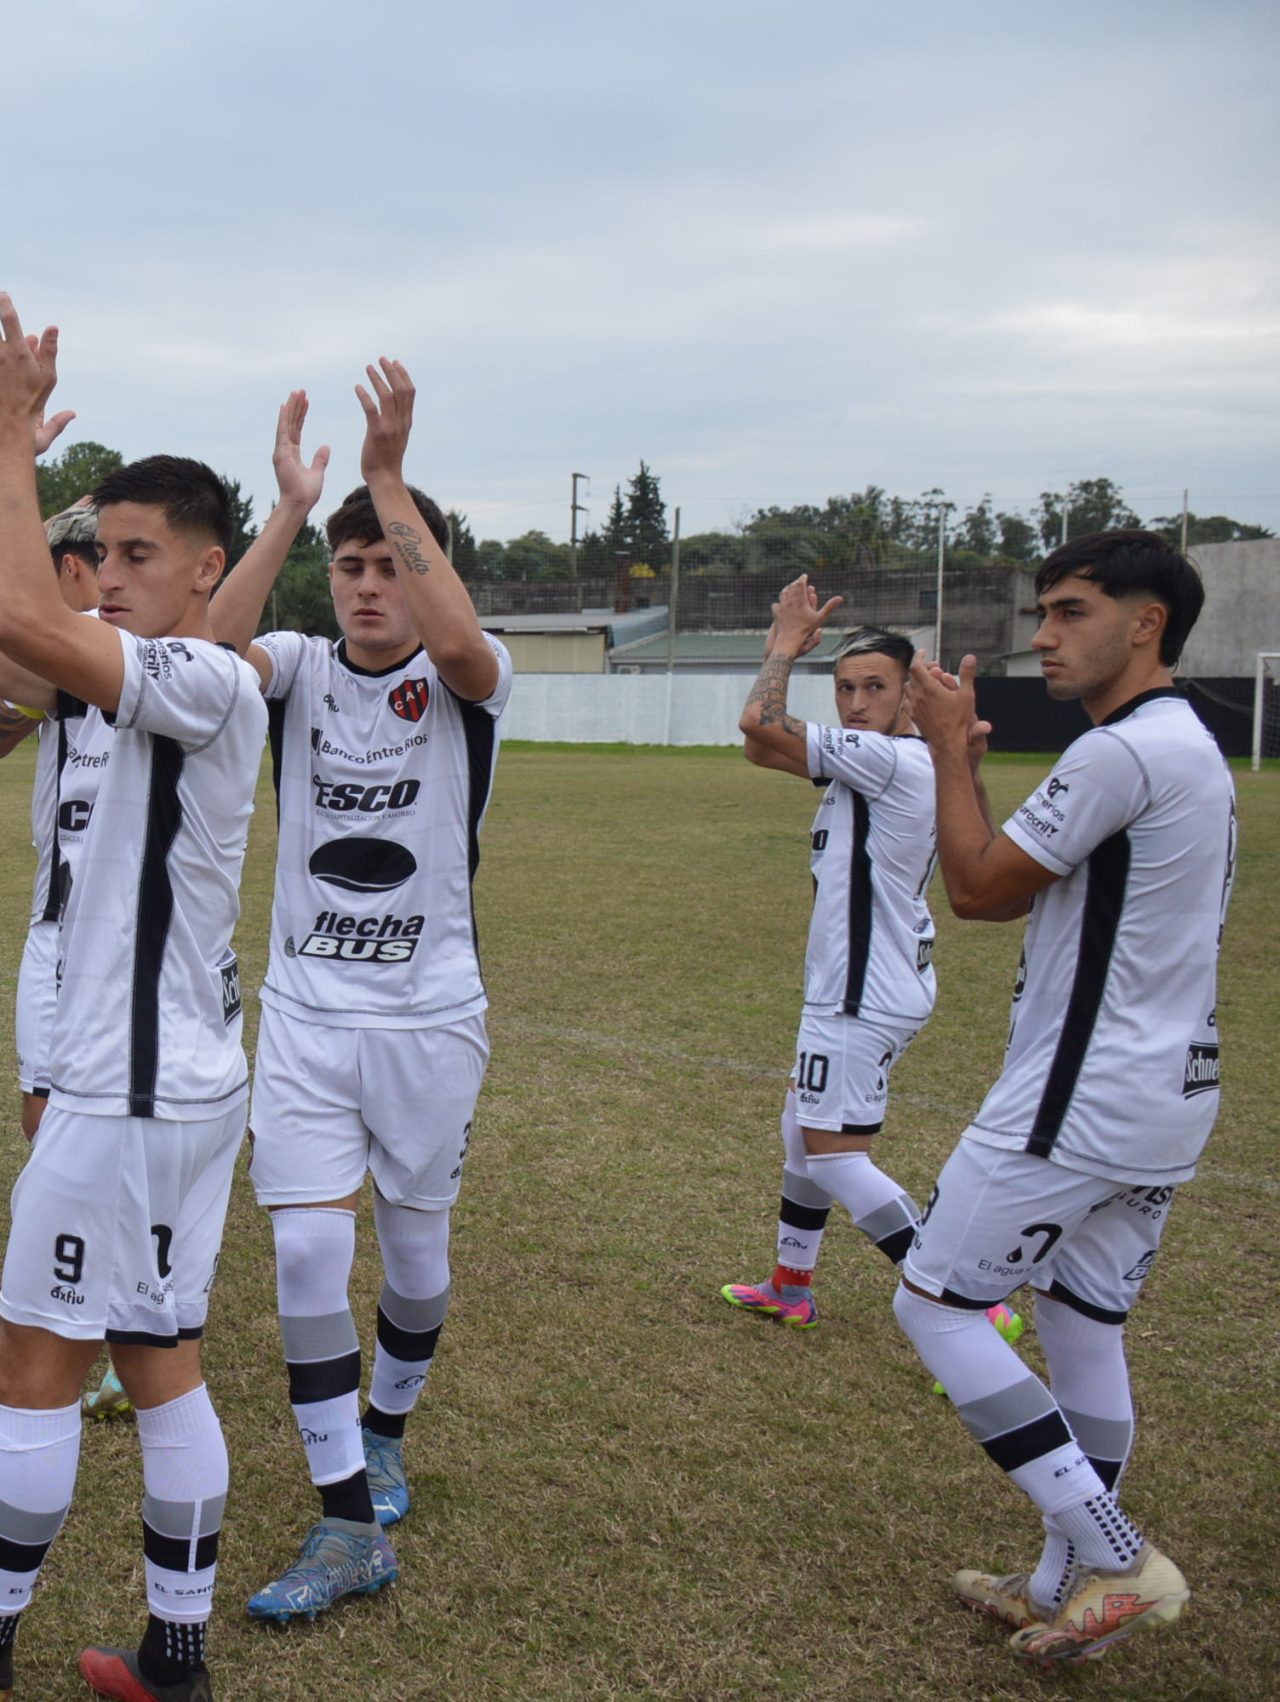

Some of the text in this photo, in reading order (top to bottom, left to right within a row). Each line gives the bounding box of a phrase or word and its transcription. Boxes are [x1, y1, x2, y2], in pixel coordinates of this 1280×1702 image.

[313, 911, 425, 938] flecha
[302, 938, 412, 961] BUS
[798, 1051, 829, 1093] 10
[53, 1233, 85, 1284] 9
[978, 1259, 993, 1271] El
[136, 1281, 149, 1295] El
